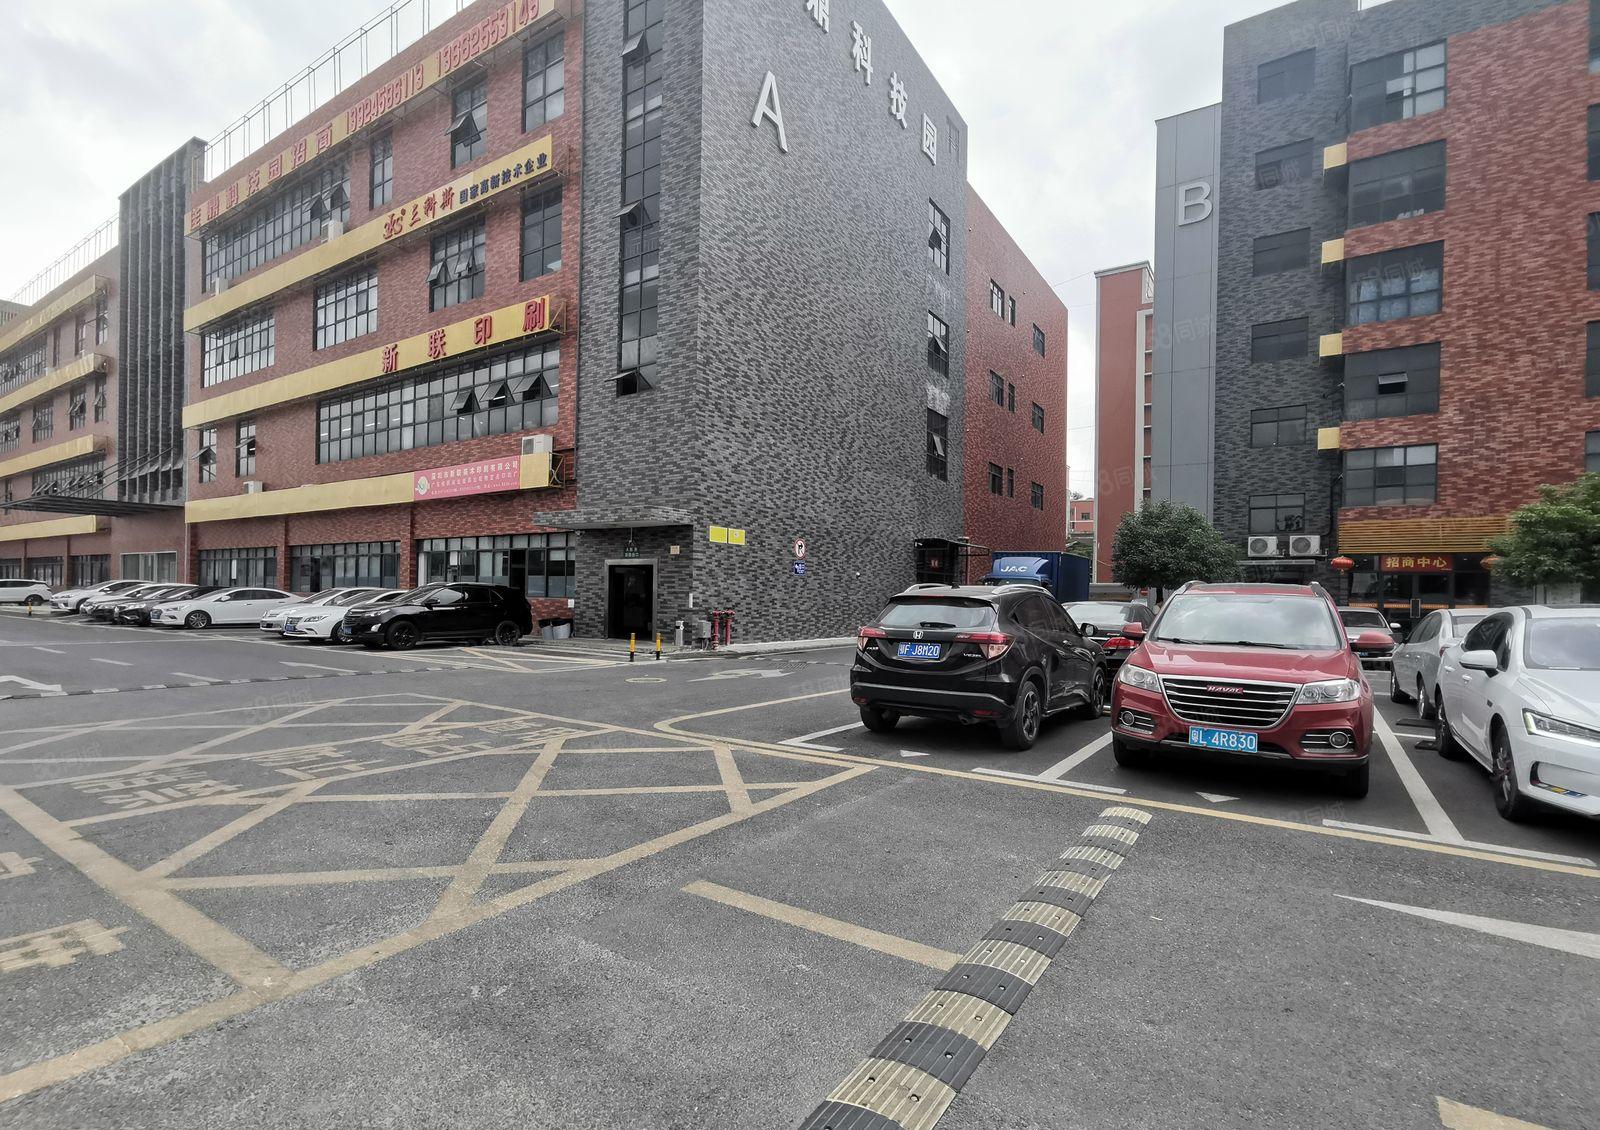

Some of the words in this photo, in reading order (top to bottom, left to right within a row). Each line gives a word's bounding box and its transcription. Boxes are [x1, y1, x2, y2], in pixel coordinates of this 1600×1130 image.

[751, 70, 788, 153] A
[459, 152, 547, 204] 国家高新技术企业
[1178, 181, 1214, 227] B
[382, 298, 546, 373] 新联印刷
[1000, 565, 1028, 573] JAC
[1386, 556, 1447, 568] 招商中心
[1207, 686, 1243, 694] HAVAL
